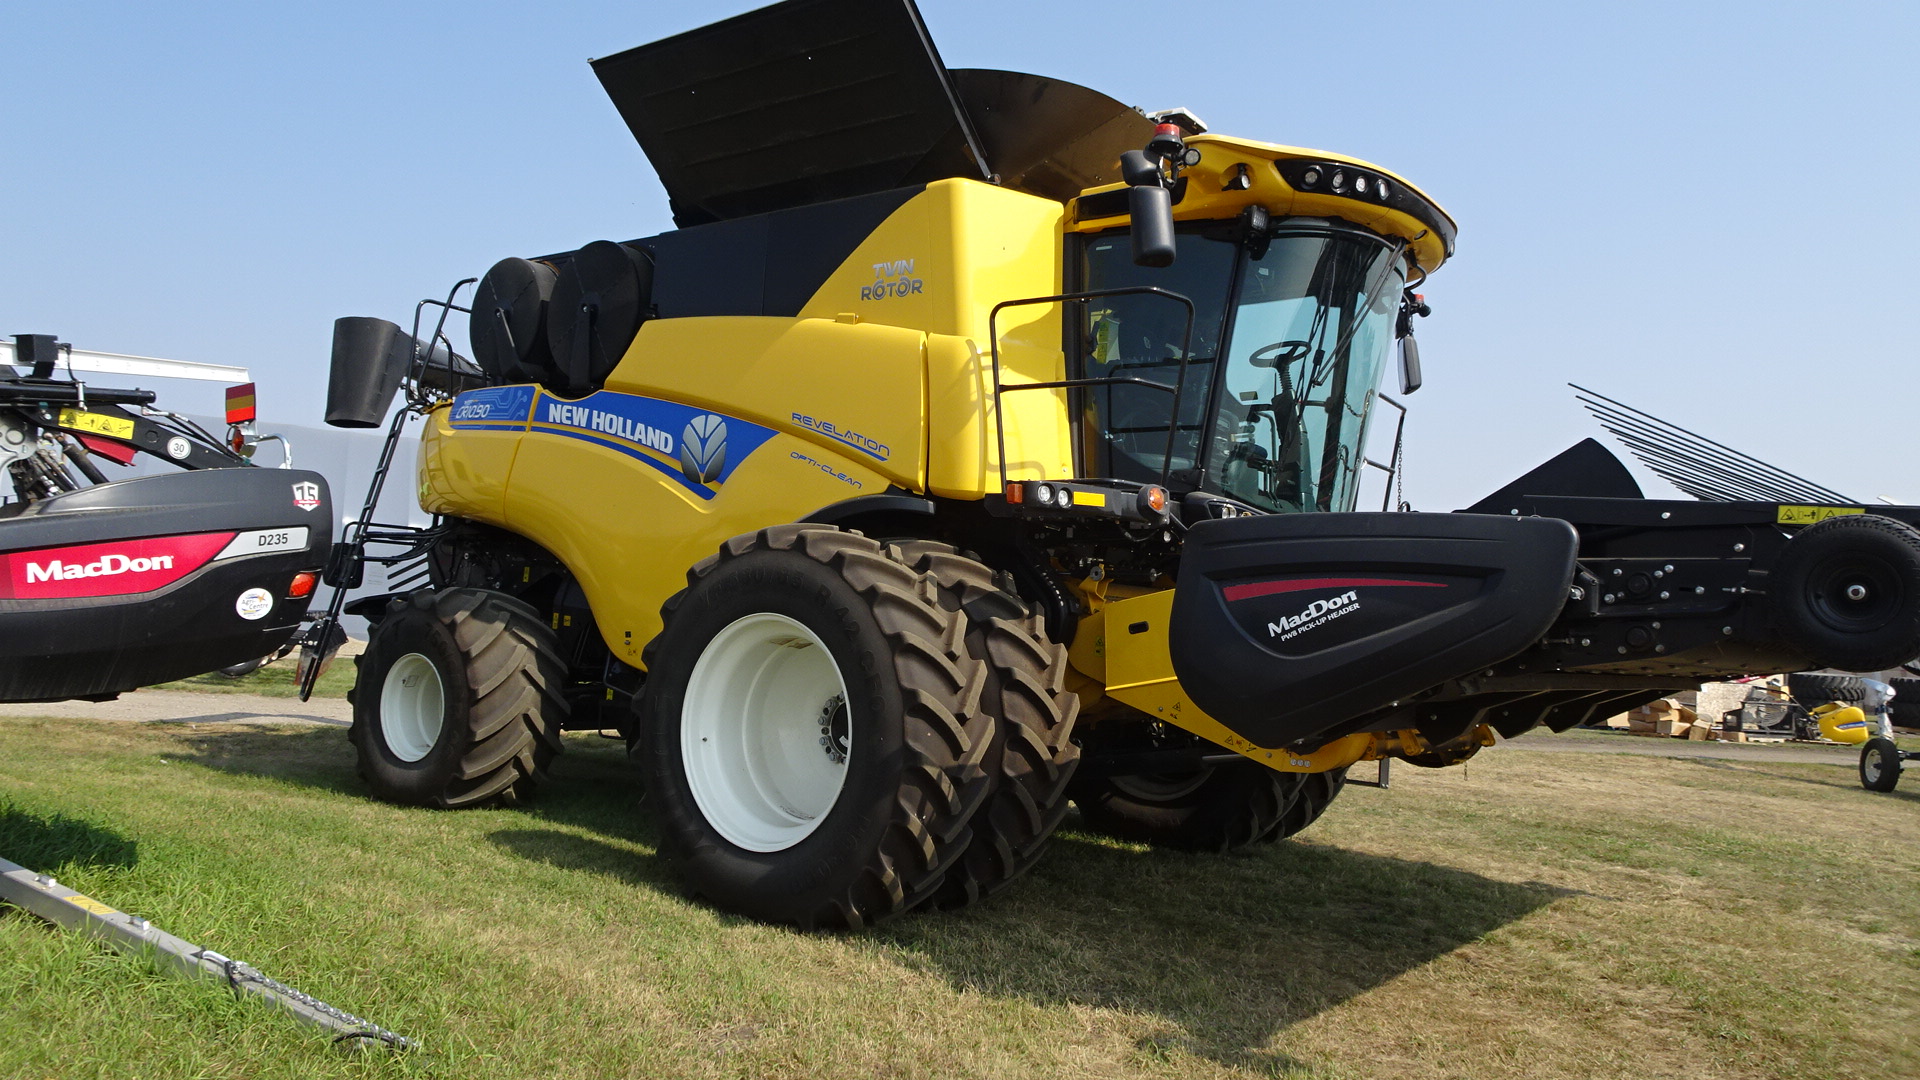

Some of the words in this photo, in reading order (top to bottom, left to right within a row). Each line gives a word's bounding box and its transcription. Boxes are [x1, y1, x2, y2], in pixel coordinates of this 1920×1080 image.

[872, 258, 915, 278] TWIN
[861, 276, 923, 301] ROTOR
[548, 403, 590, 428] NEW
[591, 409, 674, 454] HOLLAND
[791, 412, 890, 457] REVELATION
[173, 442, 185, 453] 30
[790, 451, 862, 489] OPTI-CLEAN
[258, 533, 289, 547] D235
[26, 554, 174, 583] MacDon
[1267, 590, 1358, 638] MacDon
[1281, 630, 1298, 642] PW8
[1298, 616, 1327, 634] PICK-UP
[1327, 602, 1361, 621] HEADER
